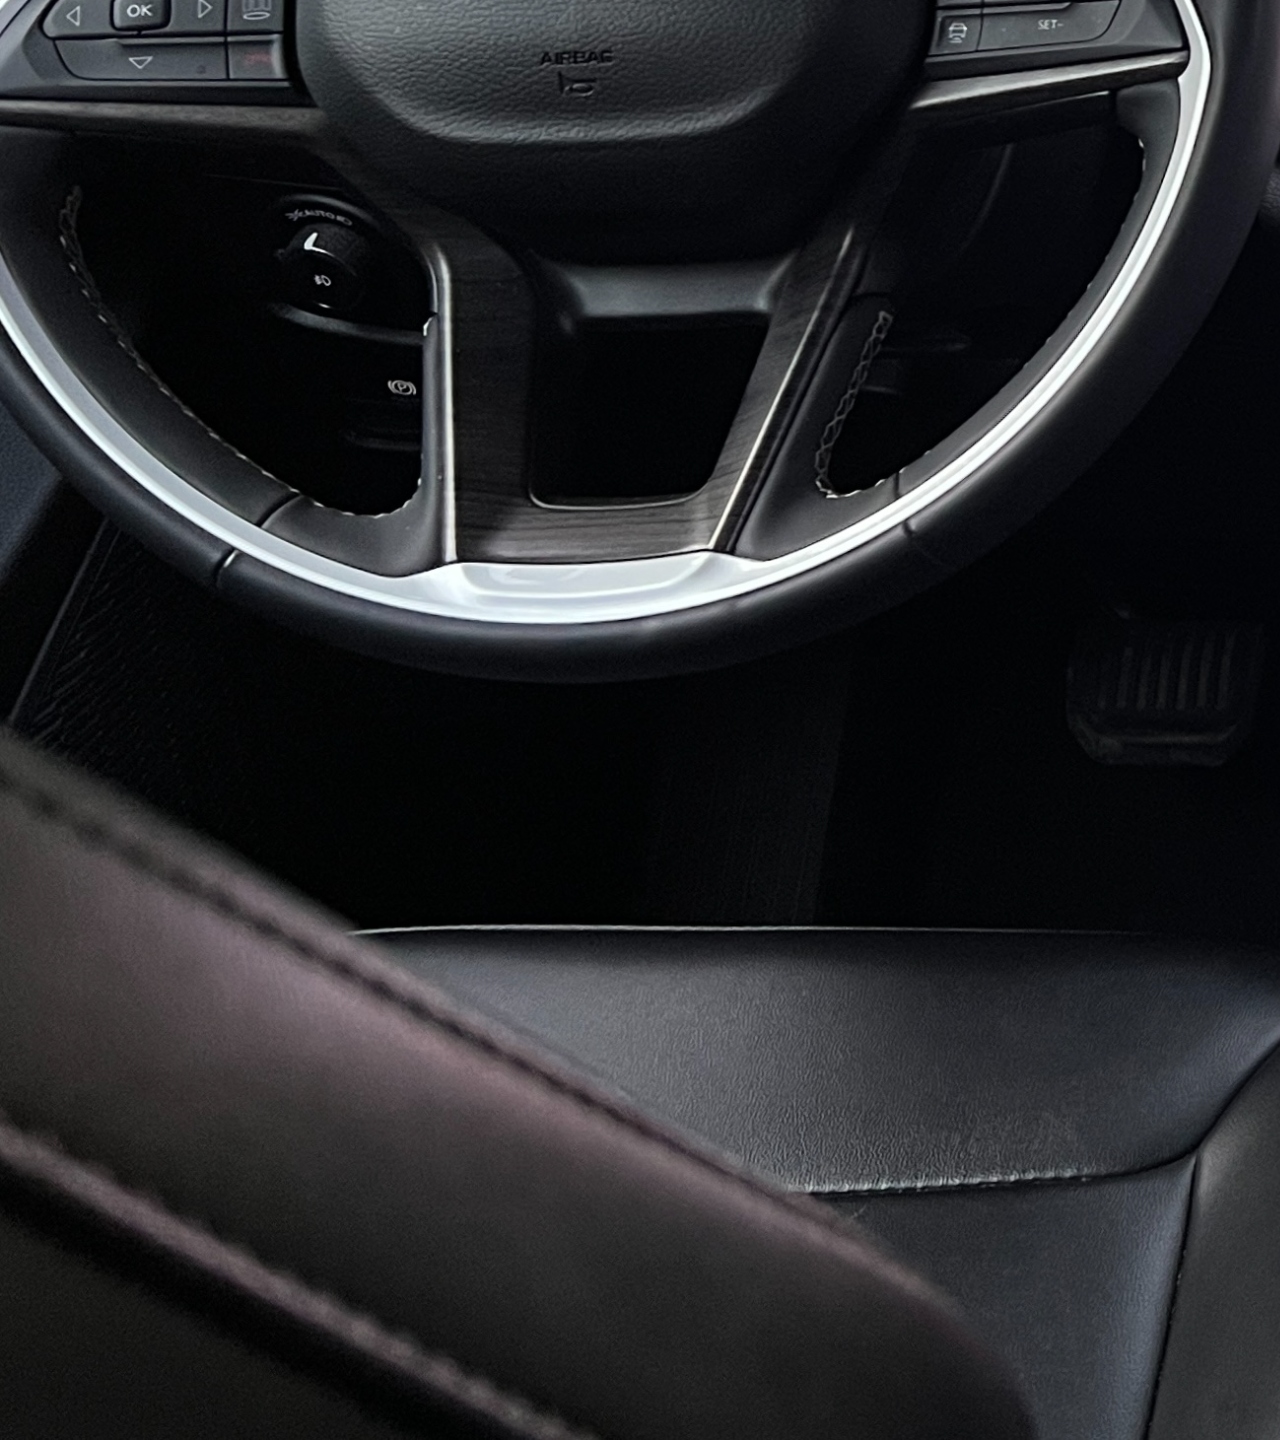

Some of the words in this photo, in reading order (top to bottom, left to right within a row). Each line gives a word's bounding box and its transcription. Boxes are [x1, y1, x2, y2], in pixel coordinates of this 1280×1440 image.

[126, 4, 153, 17] OK
[1038, 19, 1064, 30] SET-
[540, 49, 614, 66] AIRBAG
